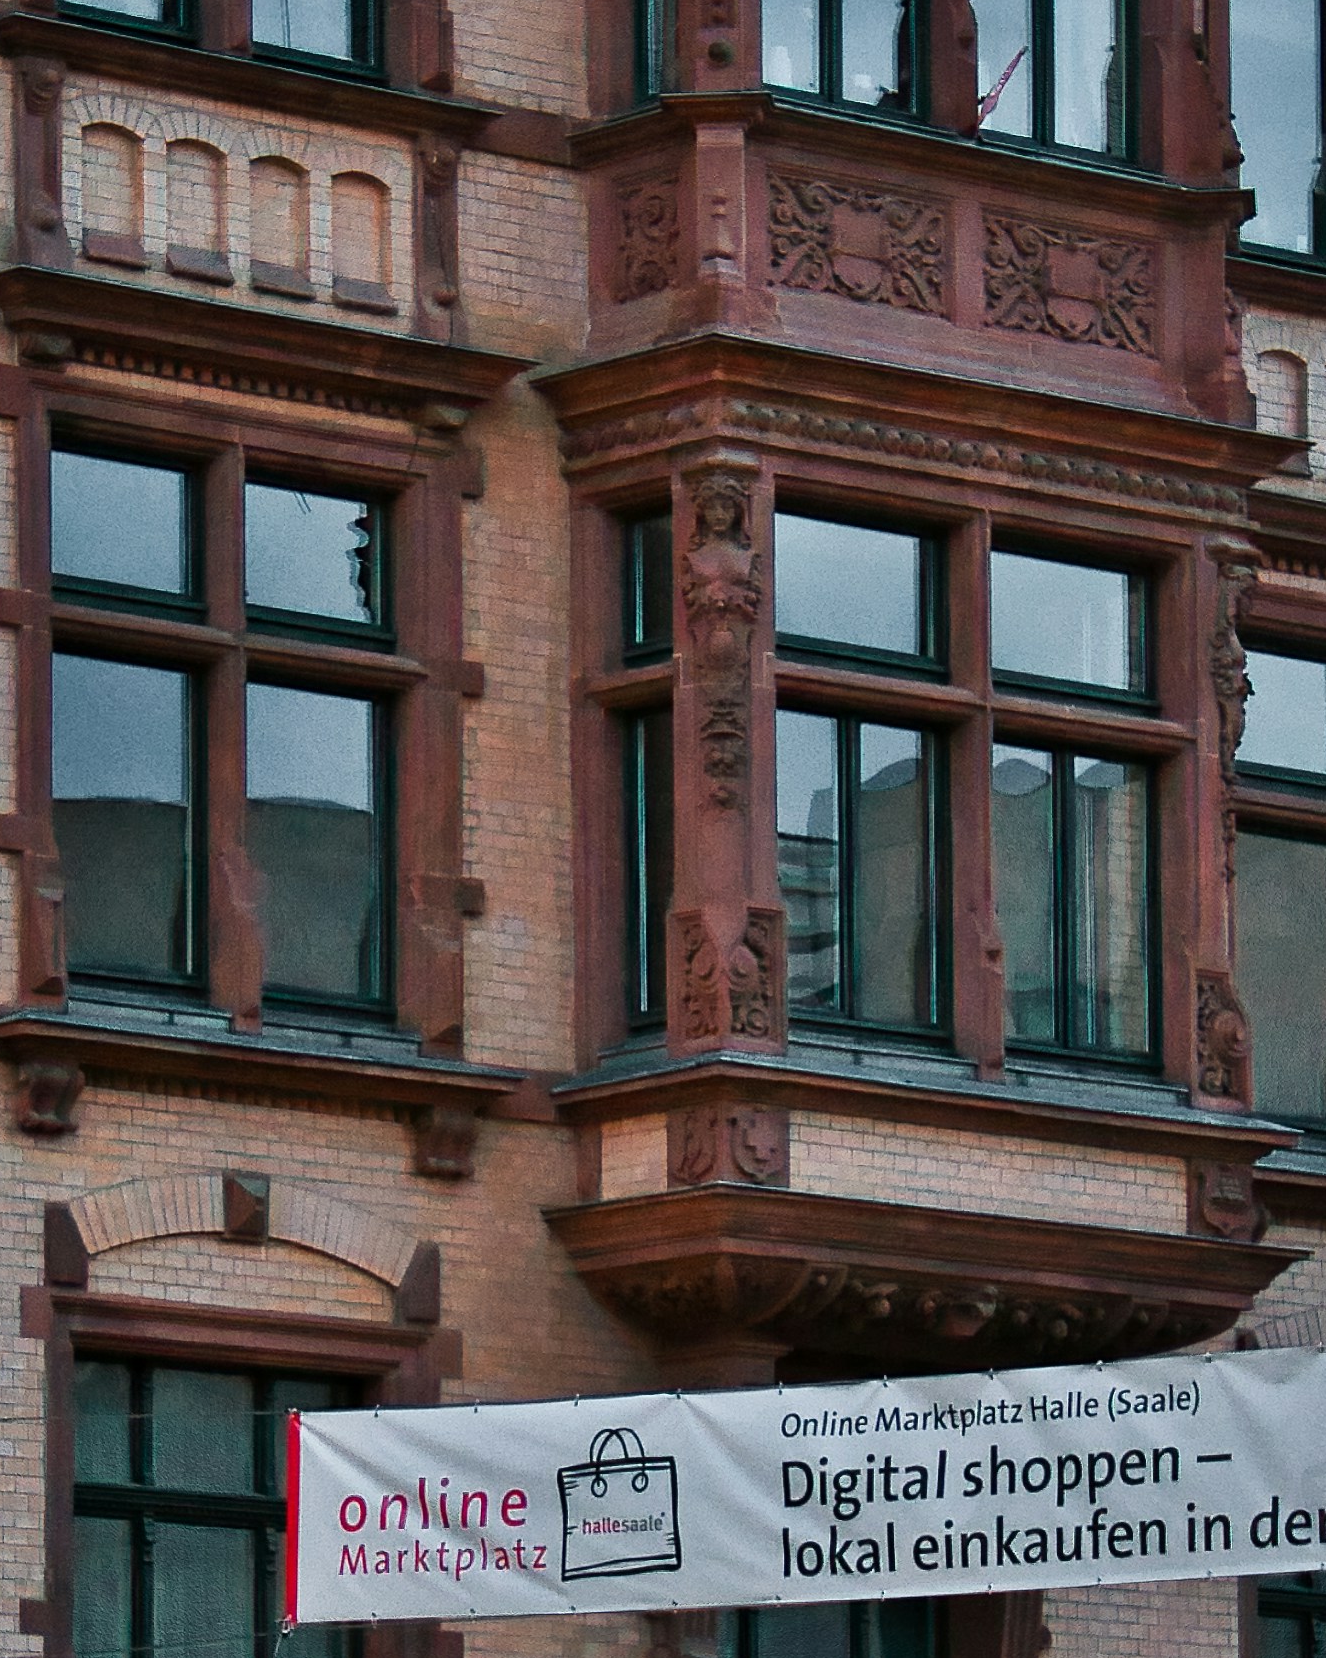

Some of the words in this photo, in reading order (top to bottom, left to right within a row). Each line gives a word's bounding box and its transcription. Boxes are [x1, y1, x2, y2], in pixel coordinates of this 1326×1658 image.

[780, 1411, 868, 1438] Online
[874, 1398, 1024, 1436] Marktplatz
[1030, 1390, 1099, 1422] Halle
[1106, 1381, 1201, 1422] (Saale)
[338, 1477, 529, 1532] online
[781, 1449, 947, 1521] Digital
[962, 1444, 1181, 1506] shoppen
[338, 1538, 548, 1581] Marktplatz
[781, 1522, 896, 1578] lokal
[912, 1507, 1167, 1570] einkaufen
[1186, 1502, 1232, 1553] in
